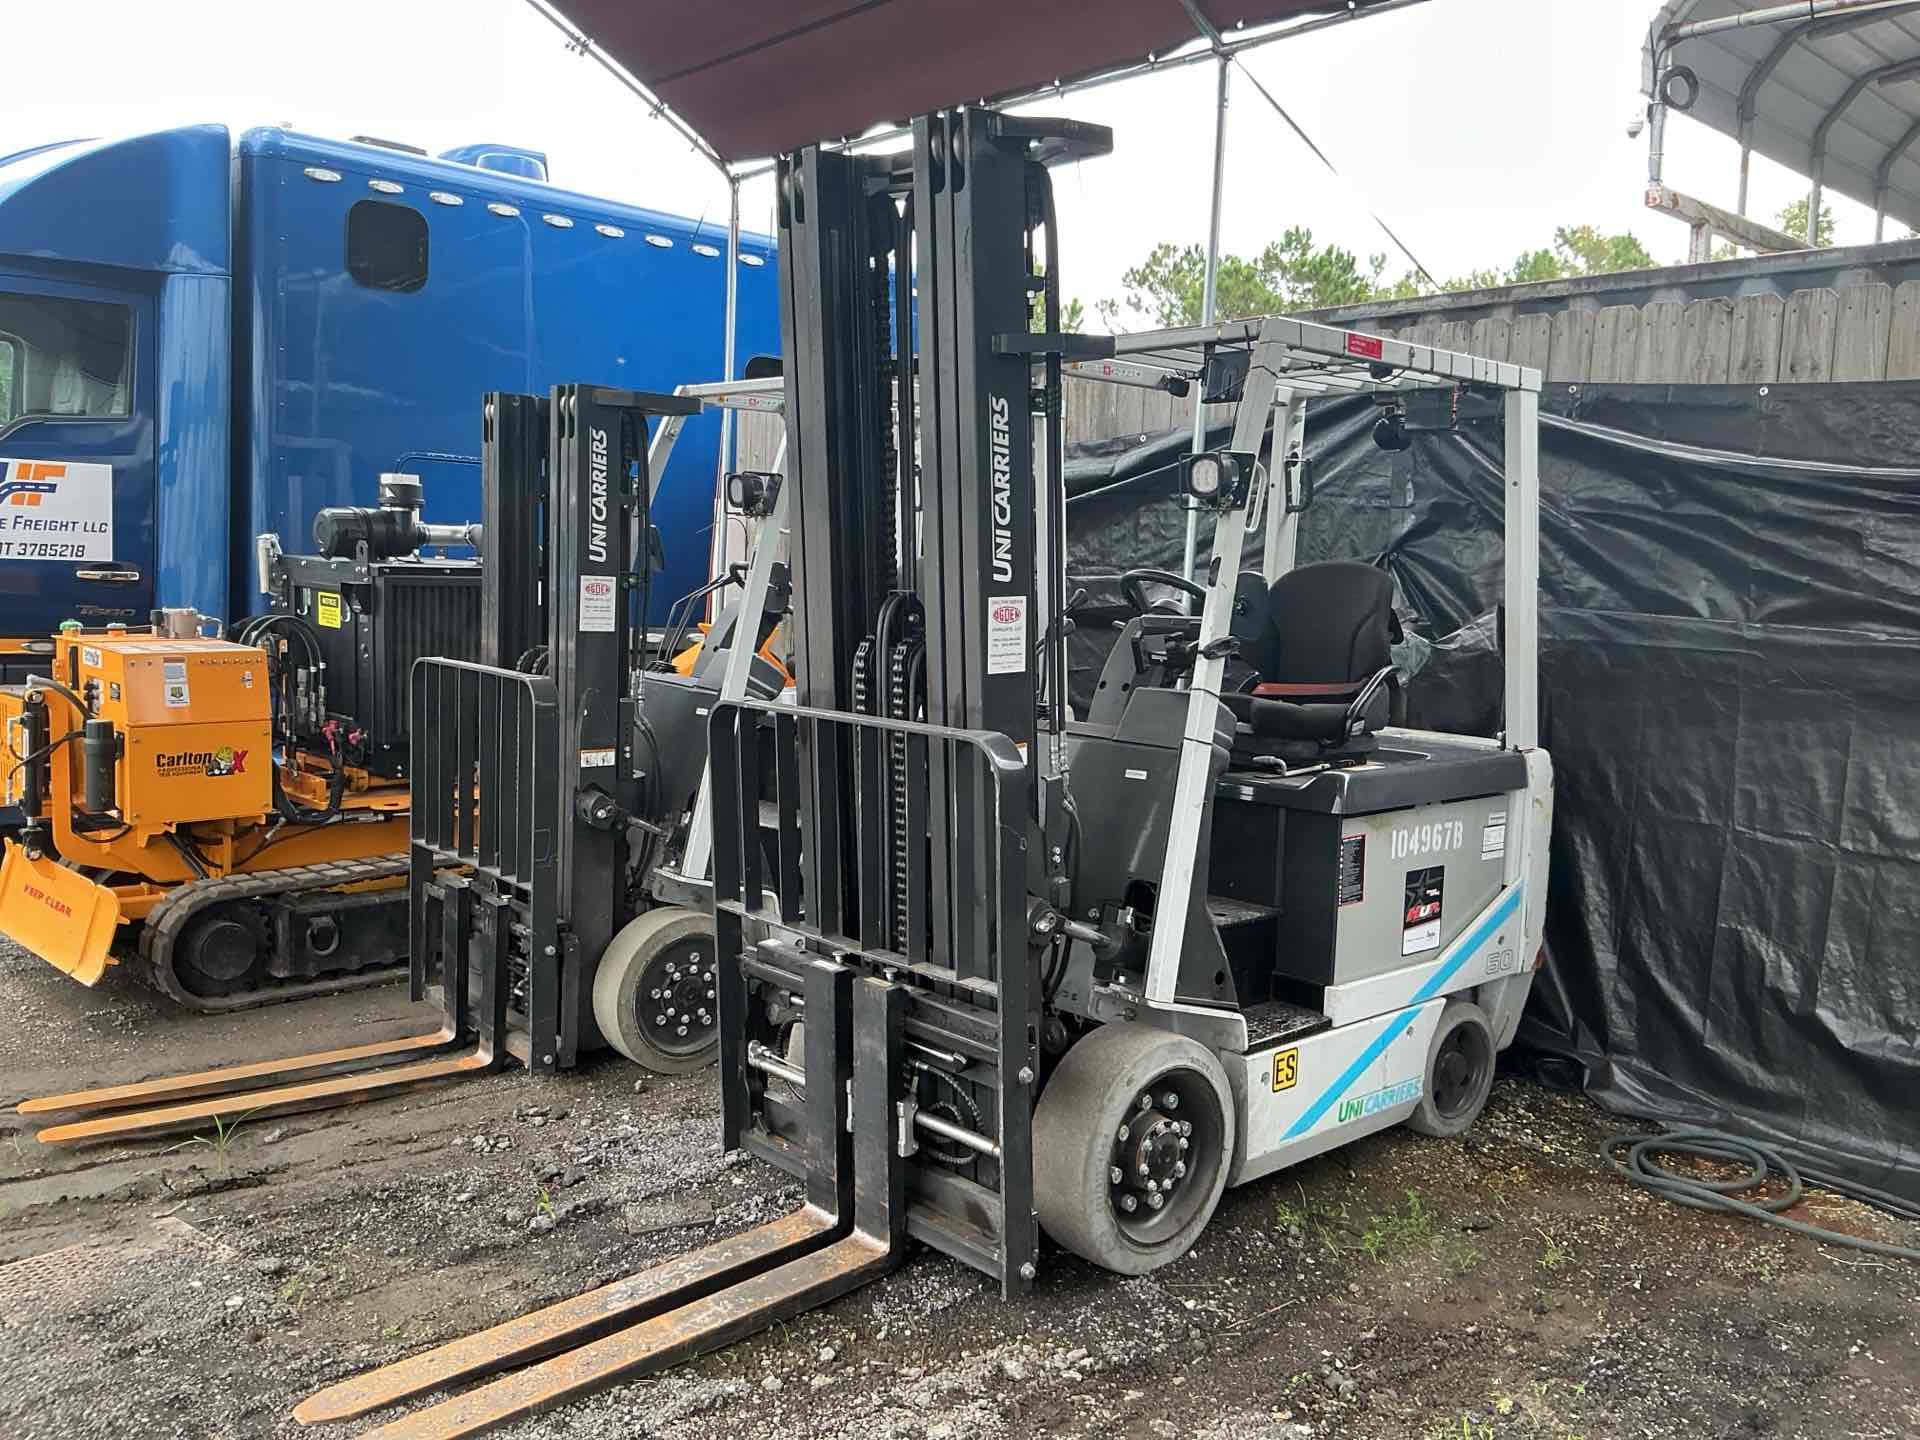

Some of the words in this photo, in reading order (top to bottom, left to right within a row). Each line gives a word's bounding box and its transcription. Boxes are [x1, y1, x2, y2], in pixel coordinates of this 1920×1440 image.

[589, 426, 608, 564] UNICARRIERS
[989, 393, 1012, 583] UNICARRIERS
[12, 515, 79, 532] FREIGHT
[83, 521, 108, 534] LLC
[17, 542, 86, 558] 3785218
[157, 753, 212, 768] Carlton
[45, 896, 72, 918] CLEAR
[1276, 1054, 1296, 1085] ES
